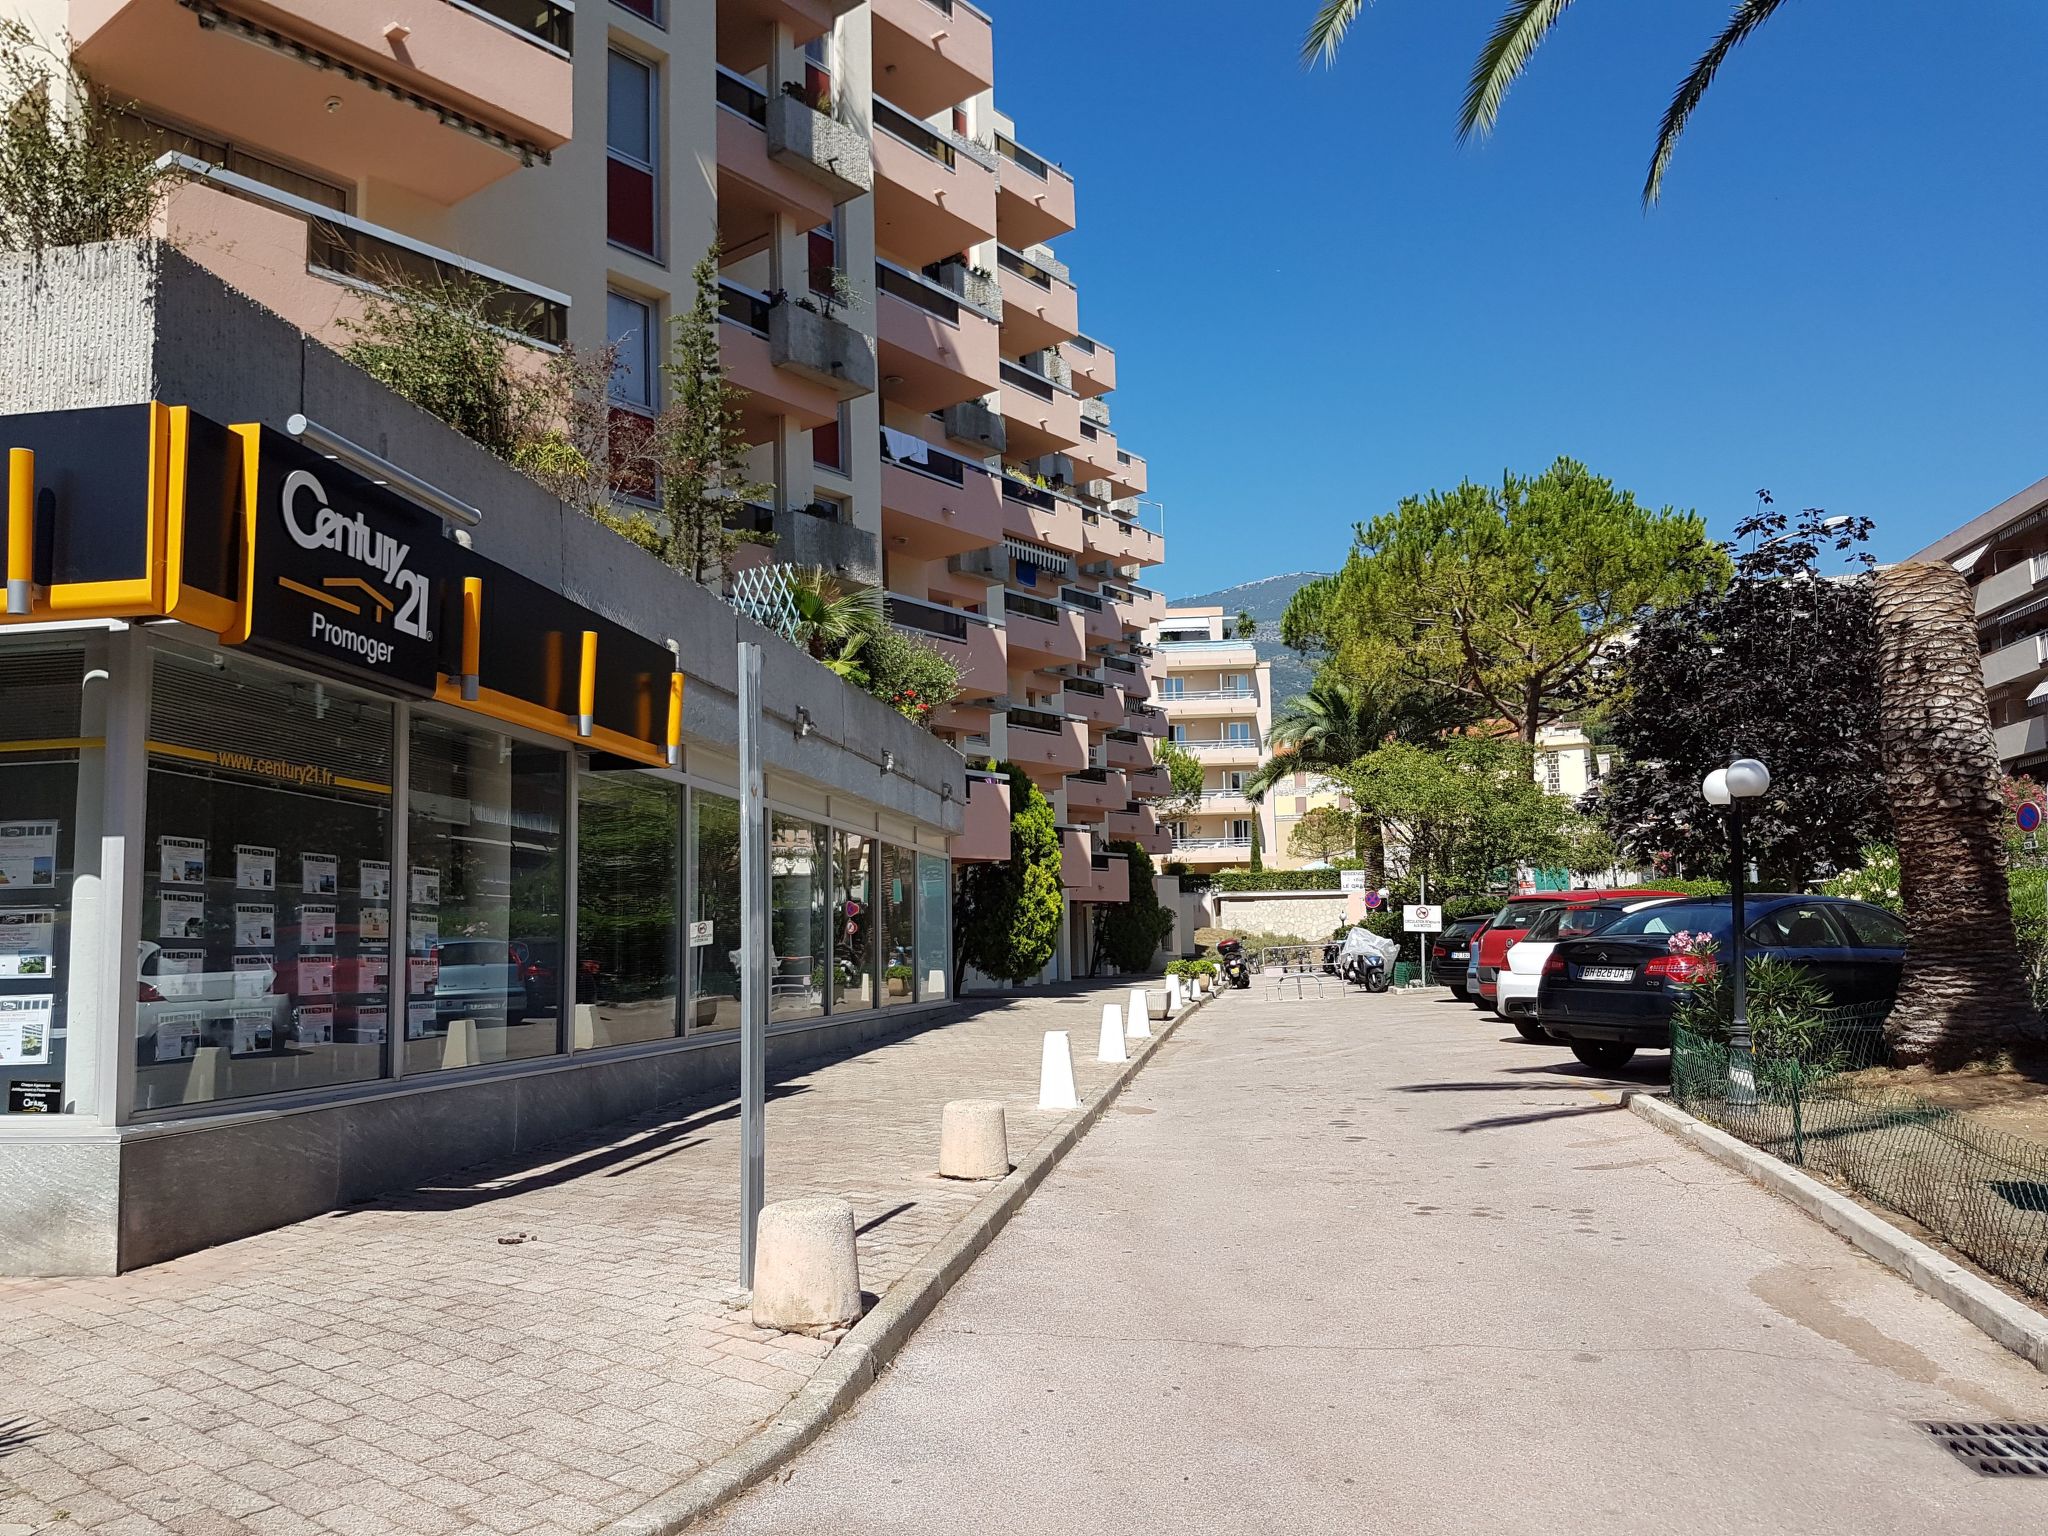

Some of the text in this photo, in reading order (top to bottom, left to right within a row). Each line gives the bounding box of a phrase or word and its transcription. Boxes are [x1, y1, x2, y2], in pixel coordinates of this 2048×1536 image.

[282, 470, 410, 584] Century
[394, 569, 429, 640] 21
[312, 611, 394, 664] Promoger
[219, 751, 332, 786] www.century21.fr
